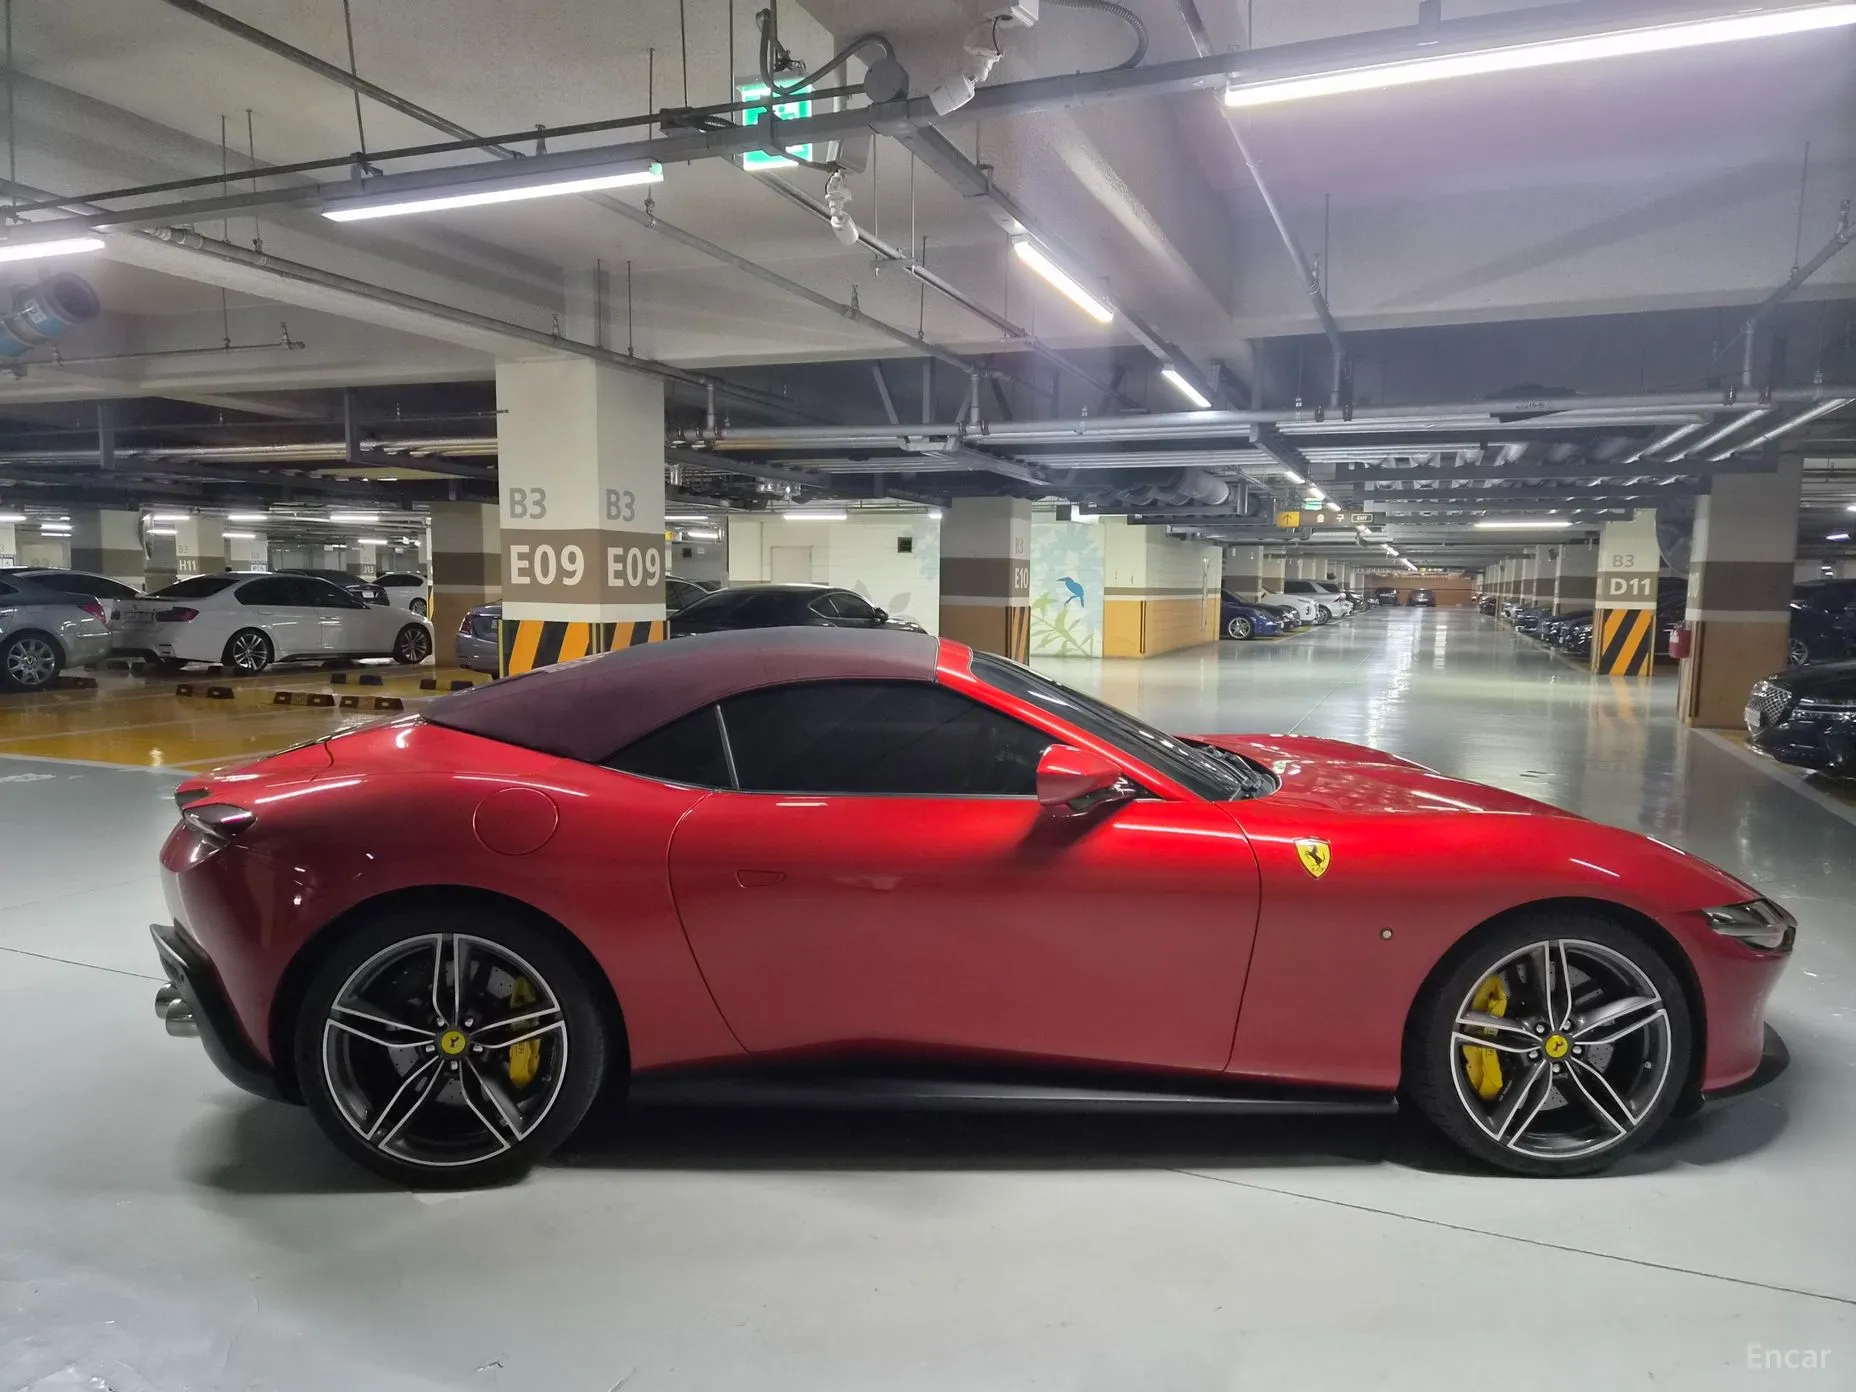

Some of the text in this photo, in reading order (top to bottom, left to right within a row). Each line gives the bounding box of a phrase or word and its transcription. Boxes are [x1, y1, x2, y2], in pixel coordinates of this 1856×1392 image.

[509, 487, 547, 519] B3
[606, 488, 636, 522] B3
[179, 559, 197, 571] H11
[510, 544, 585, 586] E09
[607, 547, 661, 587] E09
[1613, 554, 1634, 568] B3
[1014, 567, 1029, 589] E10
[1609, 578, 1651, 596] D11
